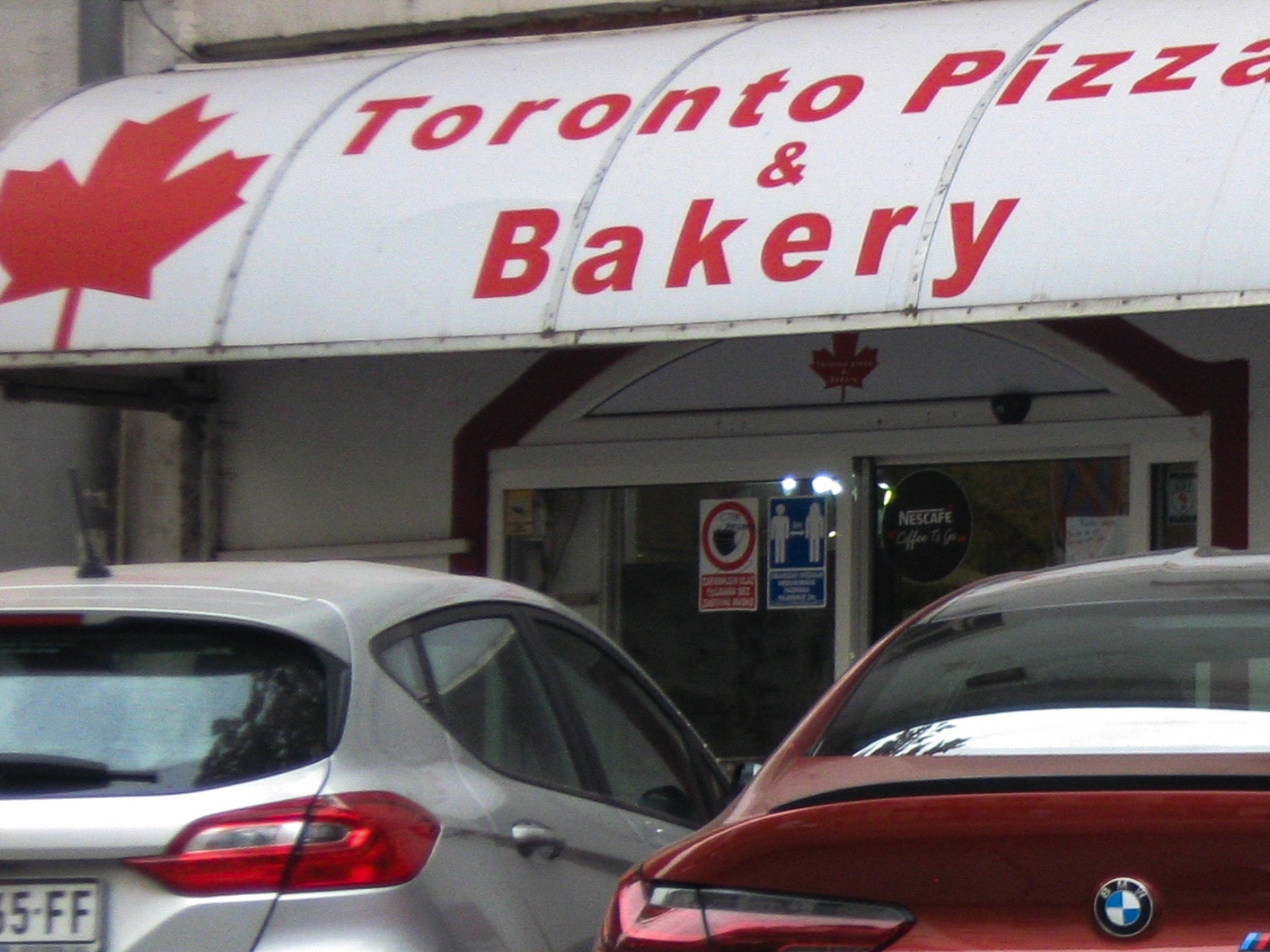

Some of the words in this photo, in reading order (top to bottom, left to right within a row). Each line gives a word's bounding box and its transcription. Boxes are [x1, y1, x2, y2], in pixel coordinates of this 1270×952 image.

[344, 68, 865, 156] Toronto
[757, 141, 807, 188] &
[473, 198, 1020, 301] Bakery
[1100, 880, 1147, 899] BMW
